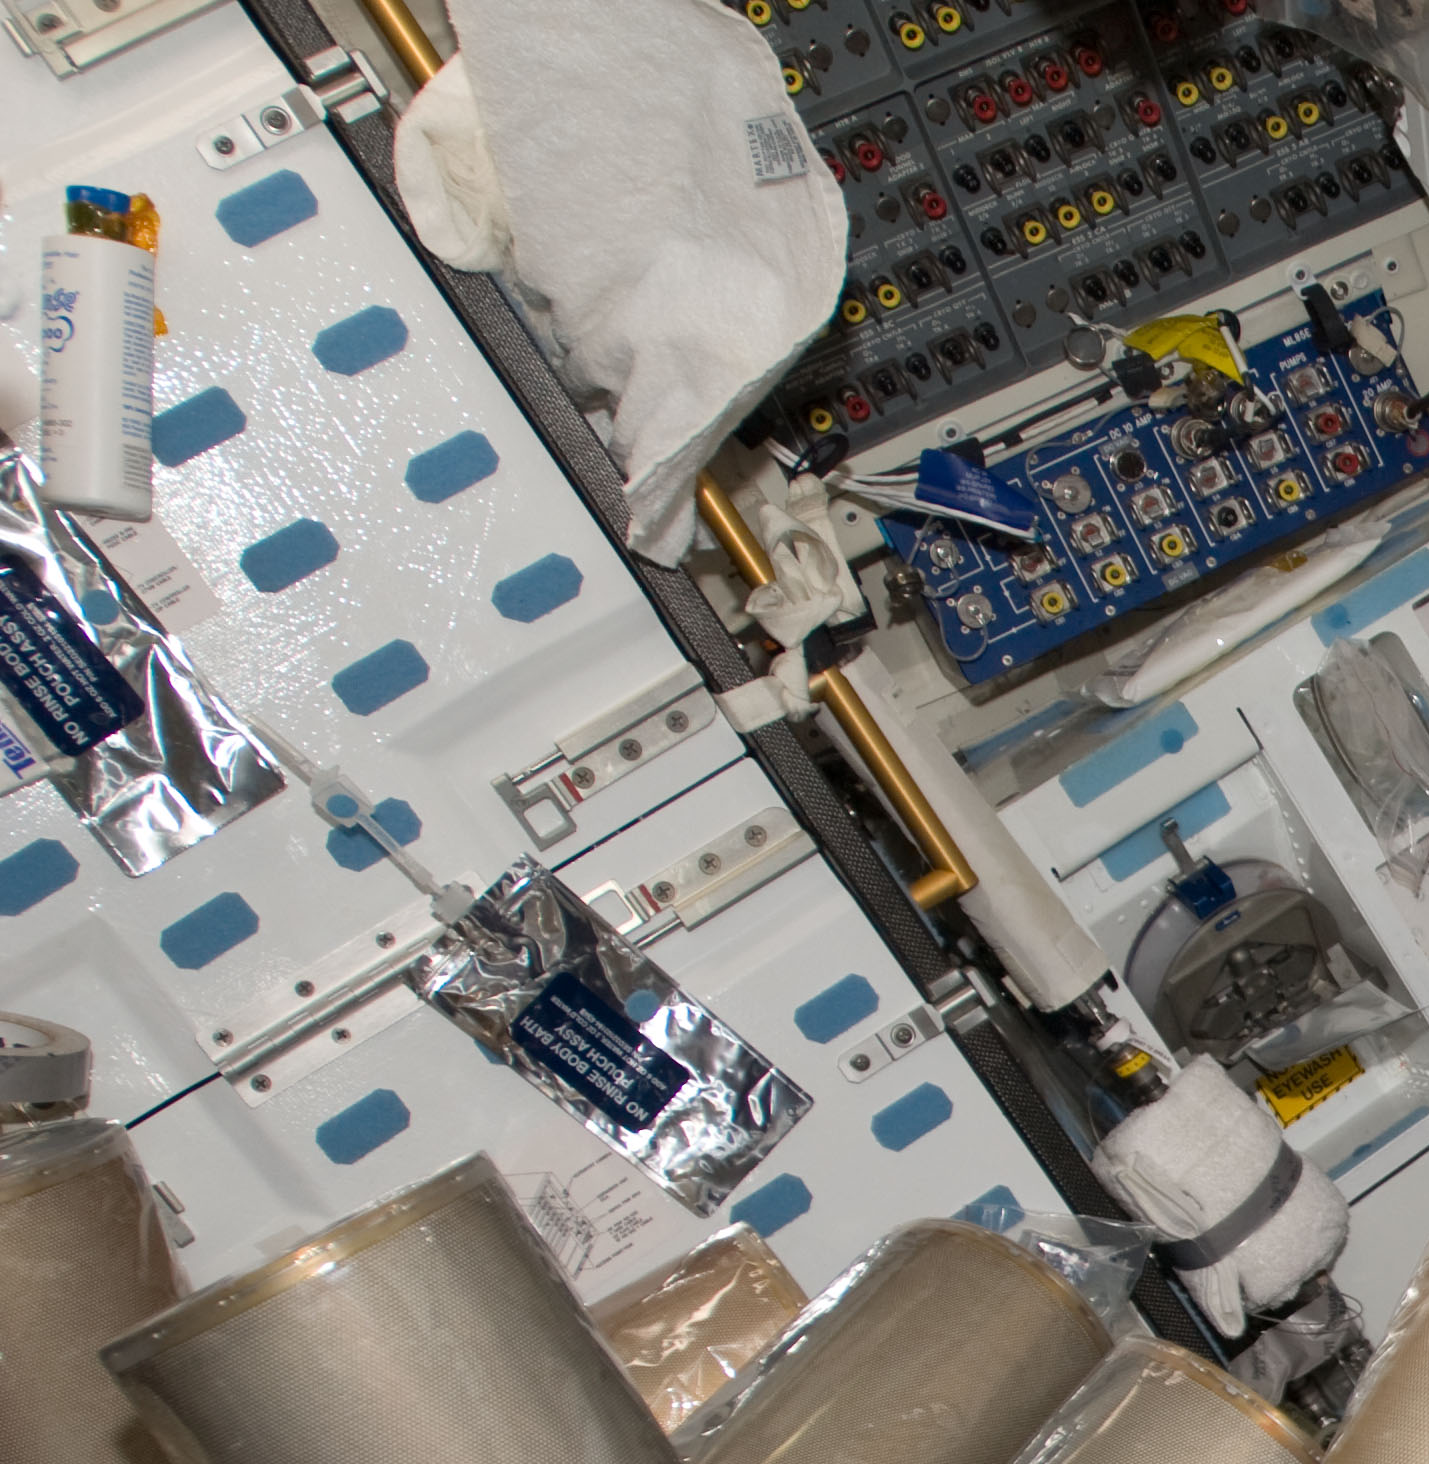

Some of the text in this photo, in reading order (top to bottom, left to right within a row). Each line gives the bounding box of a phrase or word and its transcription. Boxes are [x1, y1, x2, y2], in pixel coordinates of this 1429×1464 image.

[28, 653, 81, 707] POUCH
[24, 677, 90, 745] NO RINSE
[519, 1016, 555, 1045] BATH
[554, 1023, 591, 1052] ASSY
[550, 1042, 592, 1075] BODY
[585, 1050, 635, 1089] POUCH
[1272, 1049, 1343, 1100] EYEWASH
[586, 1068, 628, 1105] RINSE
[1300, 1074, 1333, 1101] USE
[625, 1100, 649, 1122] NO
